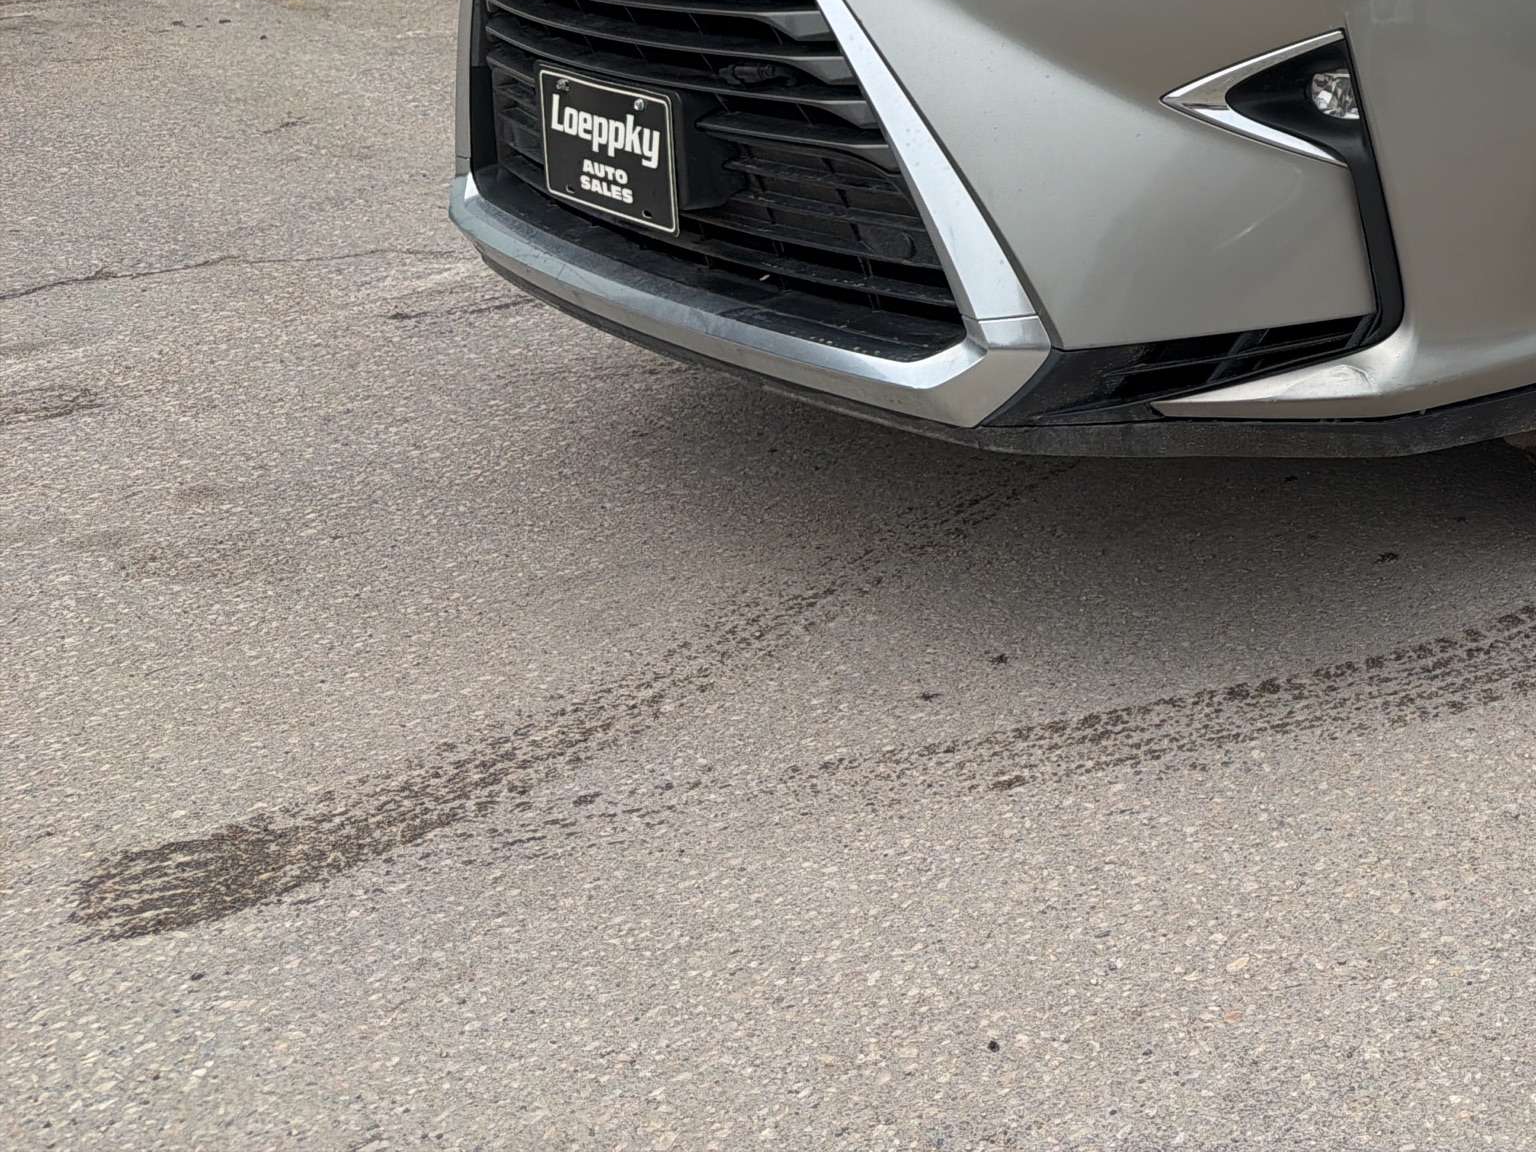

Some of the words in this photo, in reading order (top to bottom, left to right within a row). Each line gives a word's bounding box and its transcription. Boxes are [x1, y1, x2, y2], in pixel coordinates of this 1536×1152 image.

[551, 93, 660, 169] Loeppky
[582, 158, 628, 185] AUTO
[580, 174, 634, 204] SALES
